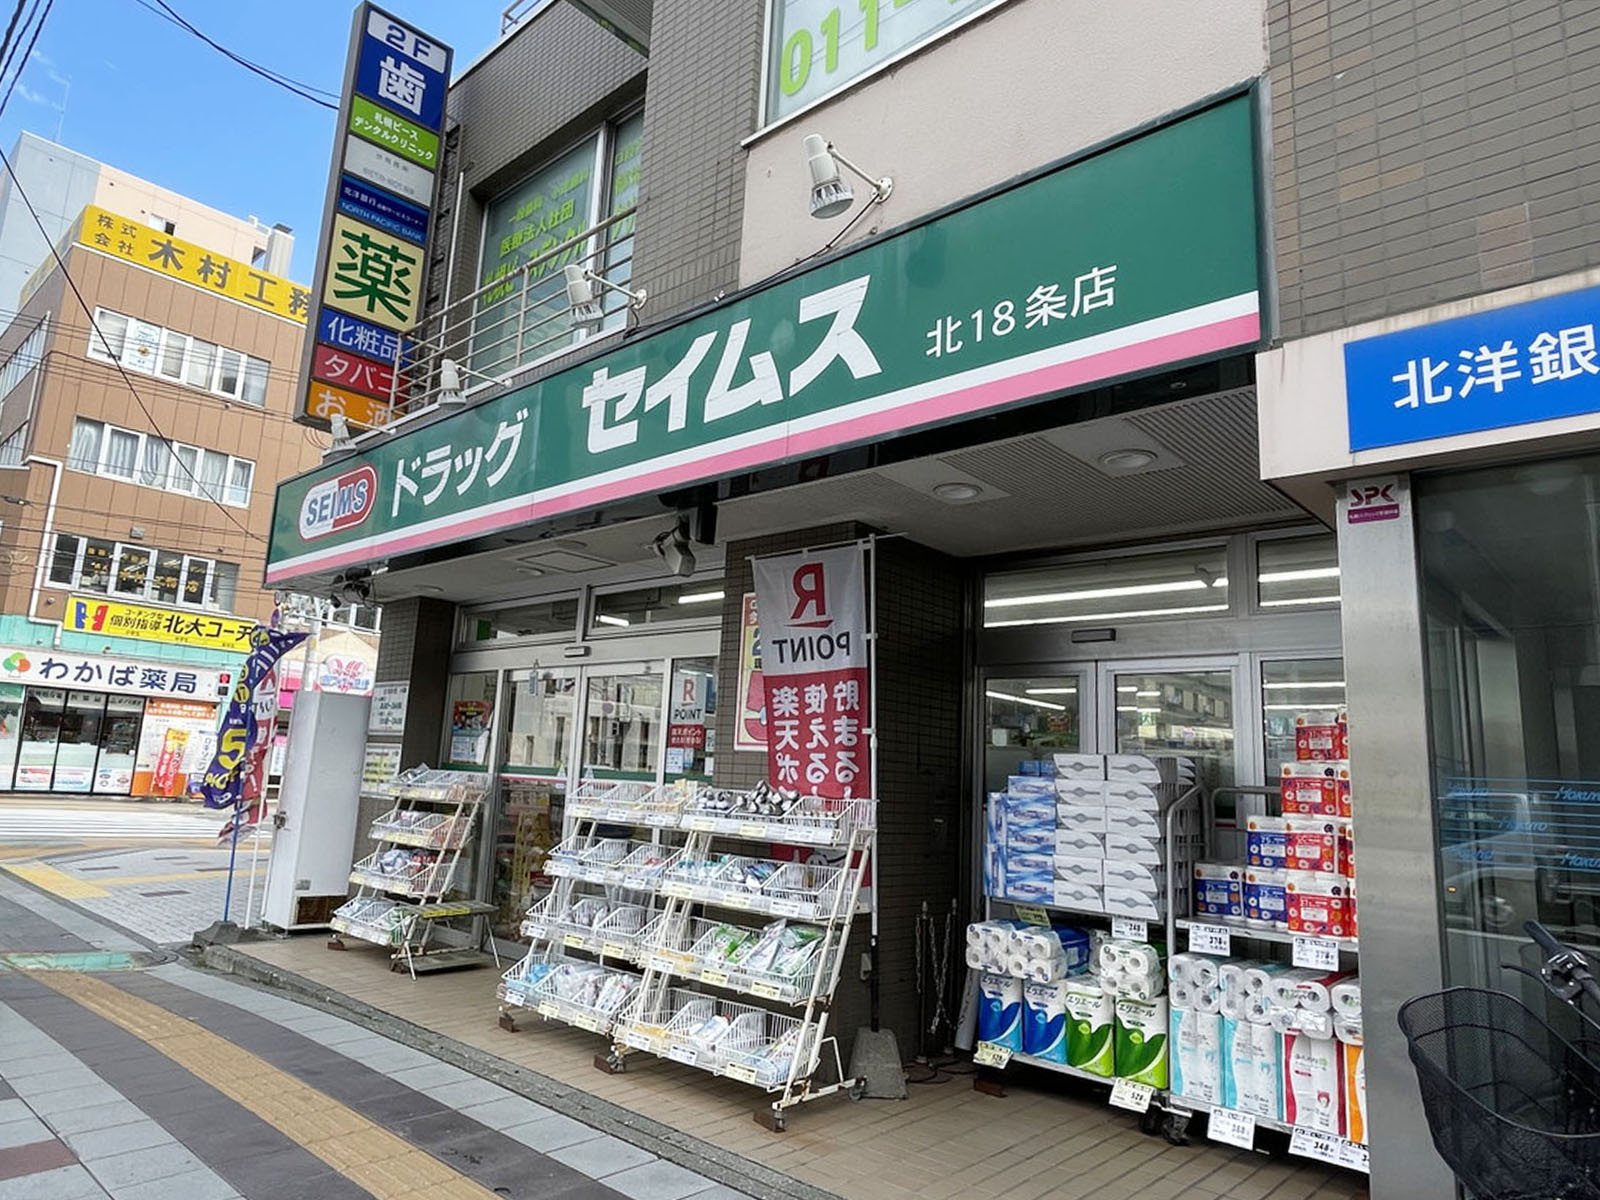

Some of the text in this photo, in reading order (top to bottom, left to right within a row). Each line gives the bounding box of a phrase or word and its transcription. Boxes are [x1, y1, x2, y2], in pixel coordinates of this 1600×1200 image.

[385, 24, 431, 58] 2F
[378, 55, 426, 116] 歯
[97, 213, 137, 238] 株式
[94, 232, 134, 257] 会社
[333, 229, 416, 322] 薬
[926, 265, 1118, 358] 北18条店
[328, 316, 402, 363] 化粧品
[325, 354, 397, 393] タバコ
[582, 274, 882, 454] セイムス
[1391, 324, 1600, 408] 北洋銀
[391, 408, 529, 518] ドラッグ
[305, 480, 368, 526] SEIMS
[110, 614, 162, 631] 個別指導
[39, 657, 198, 693] わかば薬局
[674, 708, 702, 720] POINT
[1025, 985, 1057, 999] エリエール
[1067, 994, 1101, 1009] エリエール
[1118, 1002, 1155, 1018] エリエール
